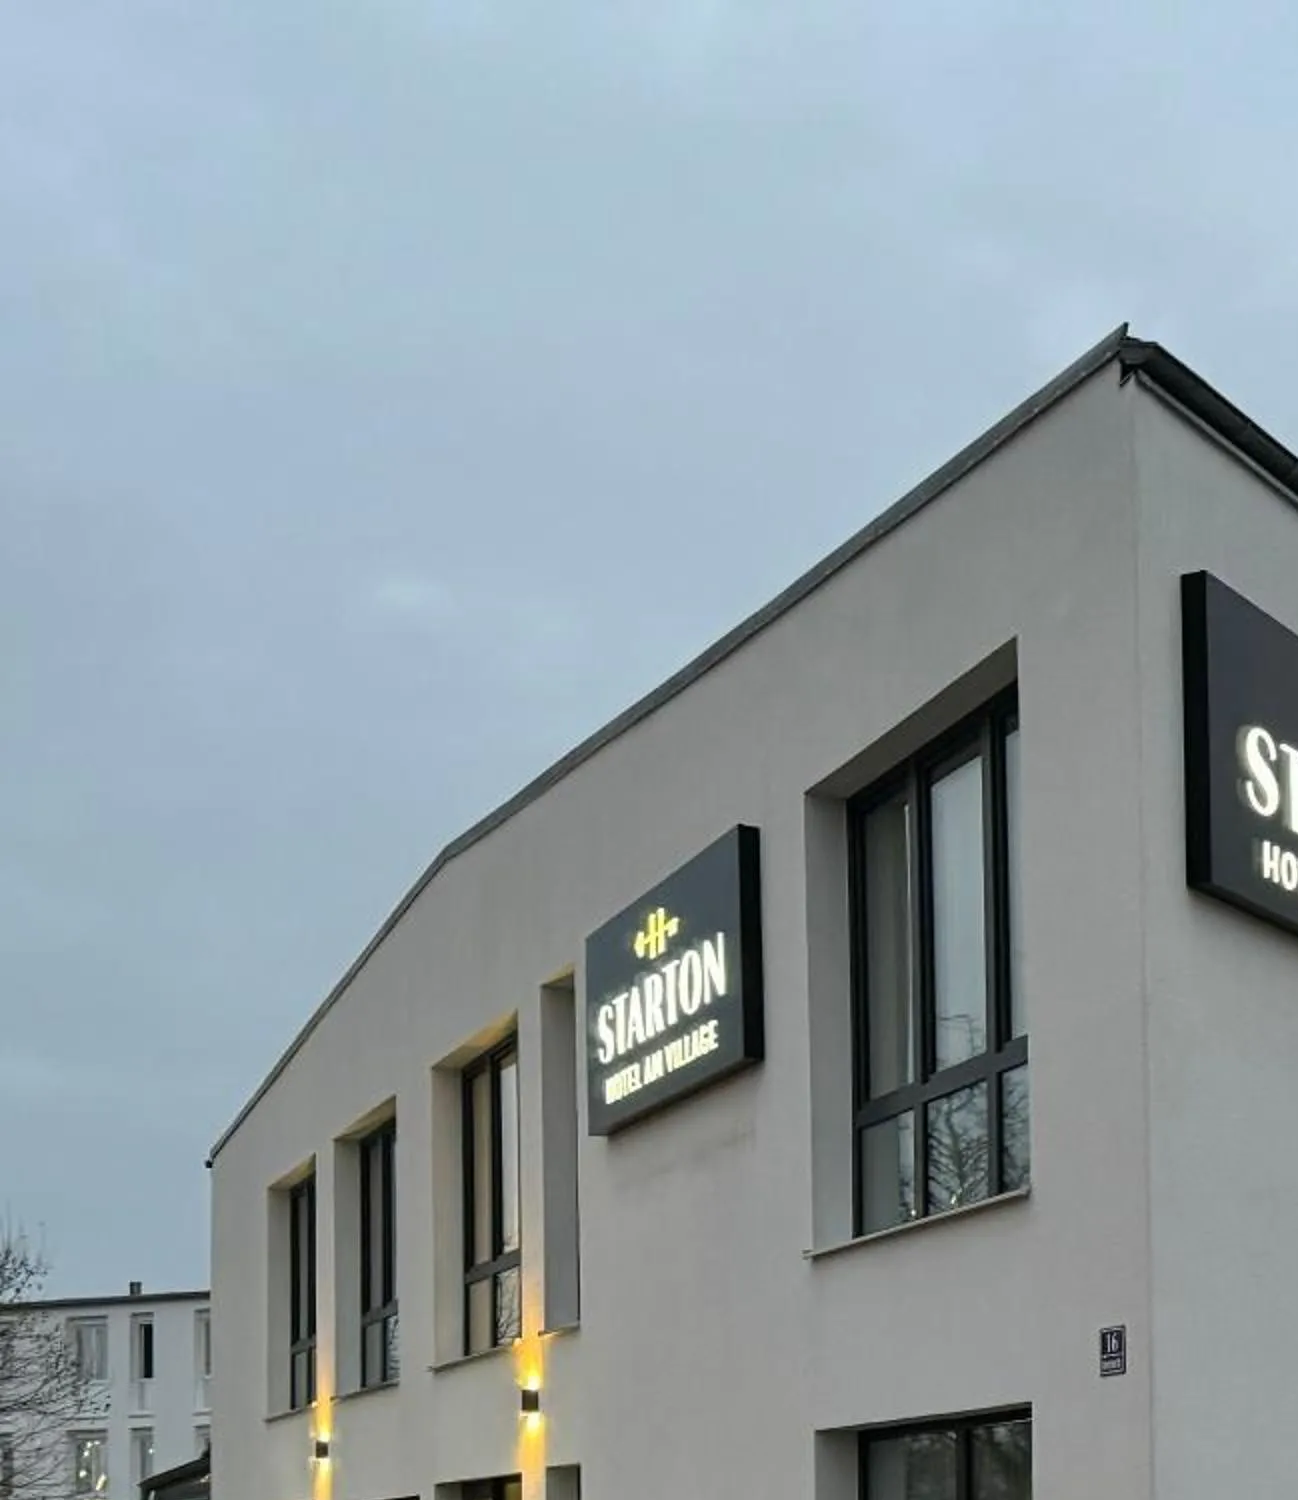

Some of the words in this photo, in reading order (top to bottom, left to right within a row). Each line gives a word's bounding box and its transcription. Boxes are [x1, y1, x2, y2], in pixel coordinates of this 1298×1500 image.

[598, 931, 727, 1065] STARTON
[605, 1062, 643, 1105] HOTEL
[663, 1019, 719, 1073] VILLAGE
